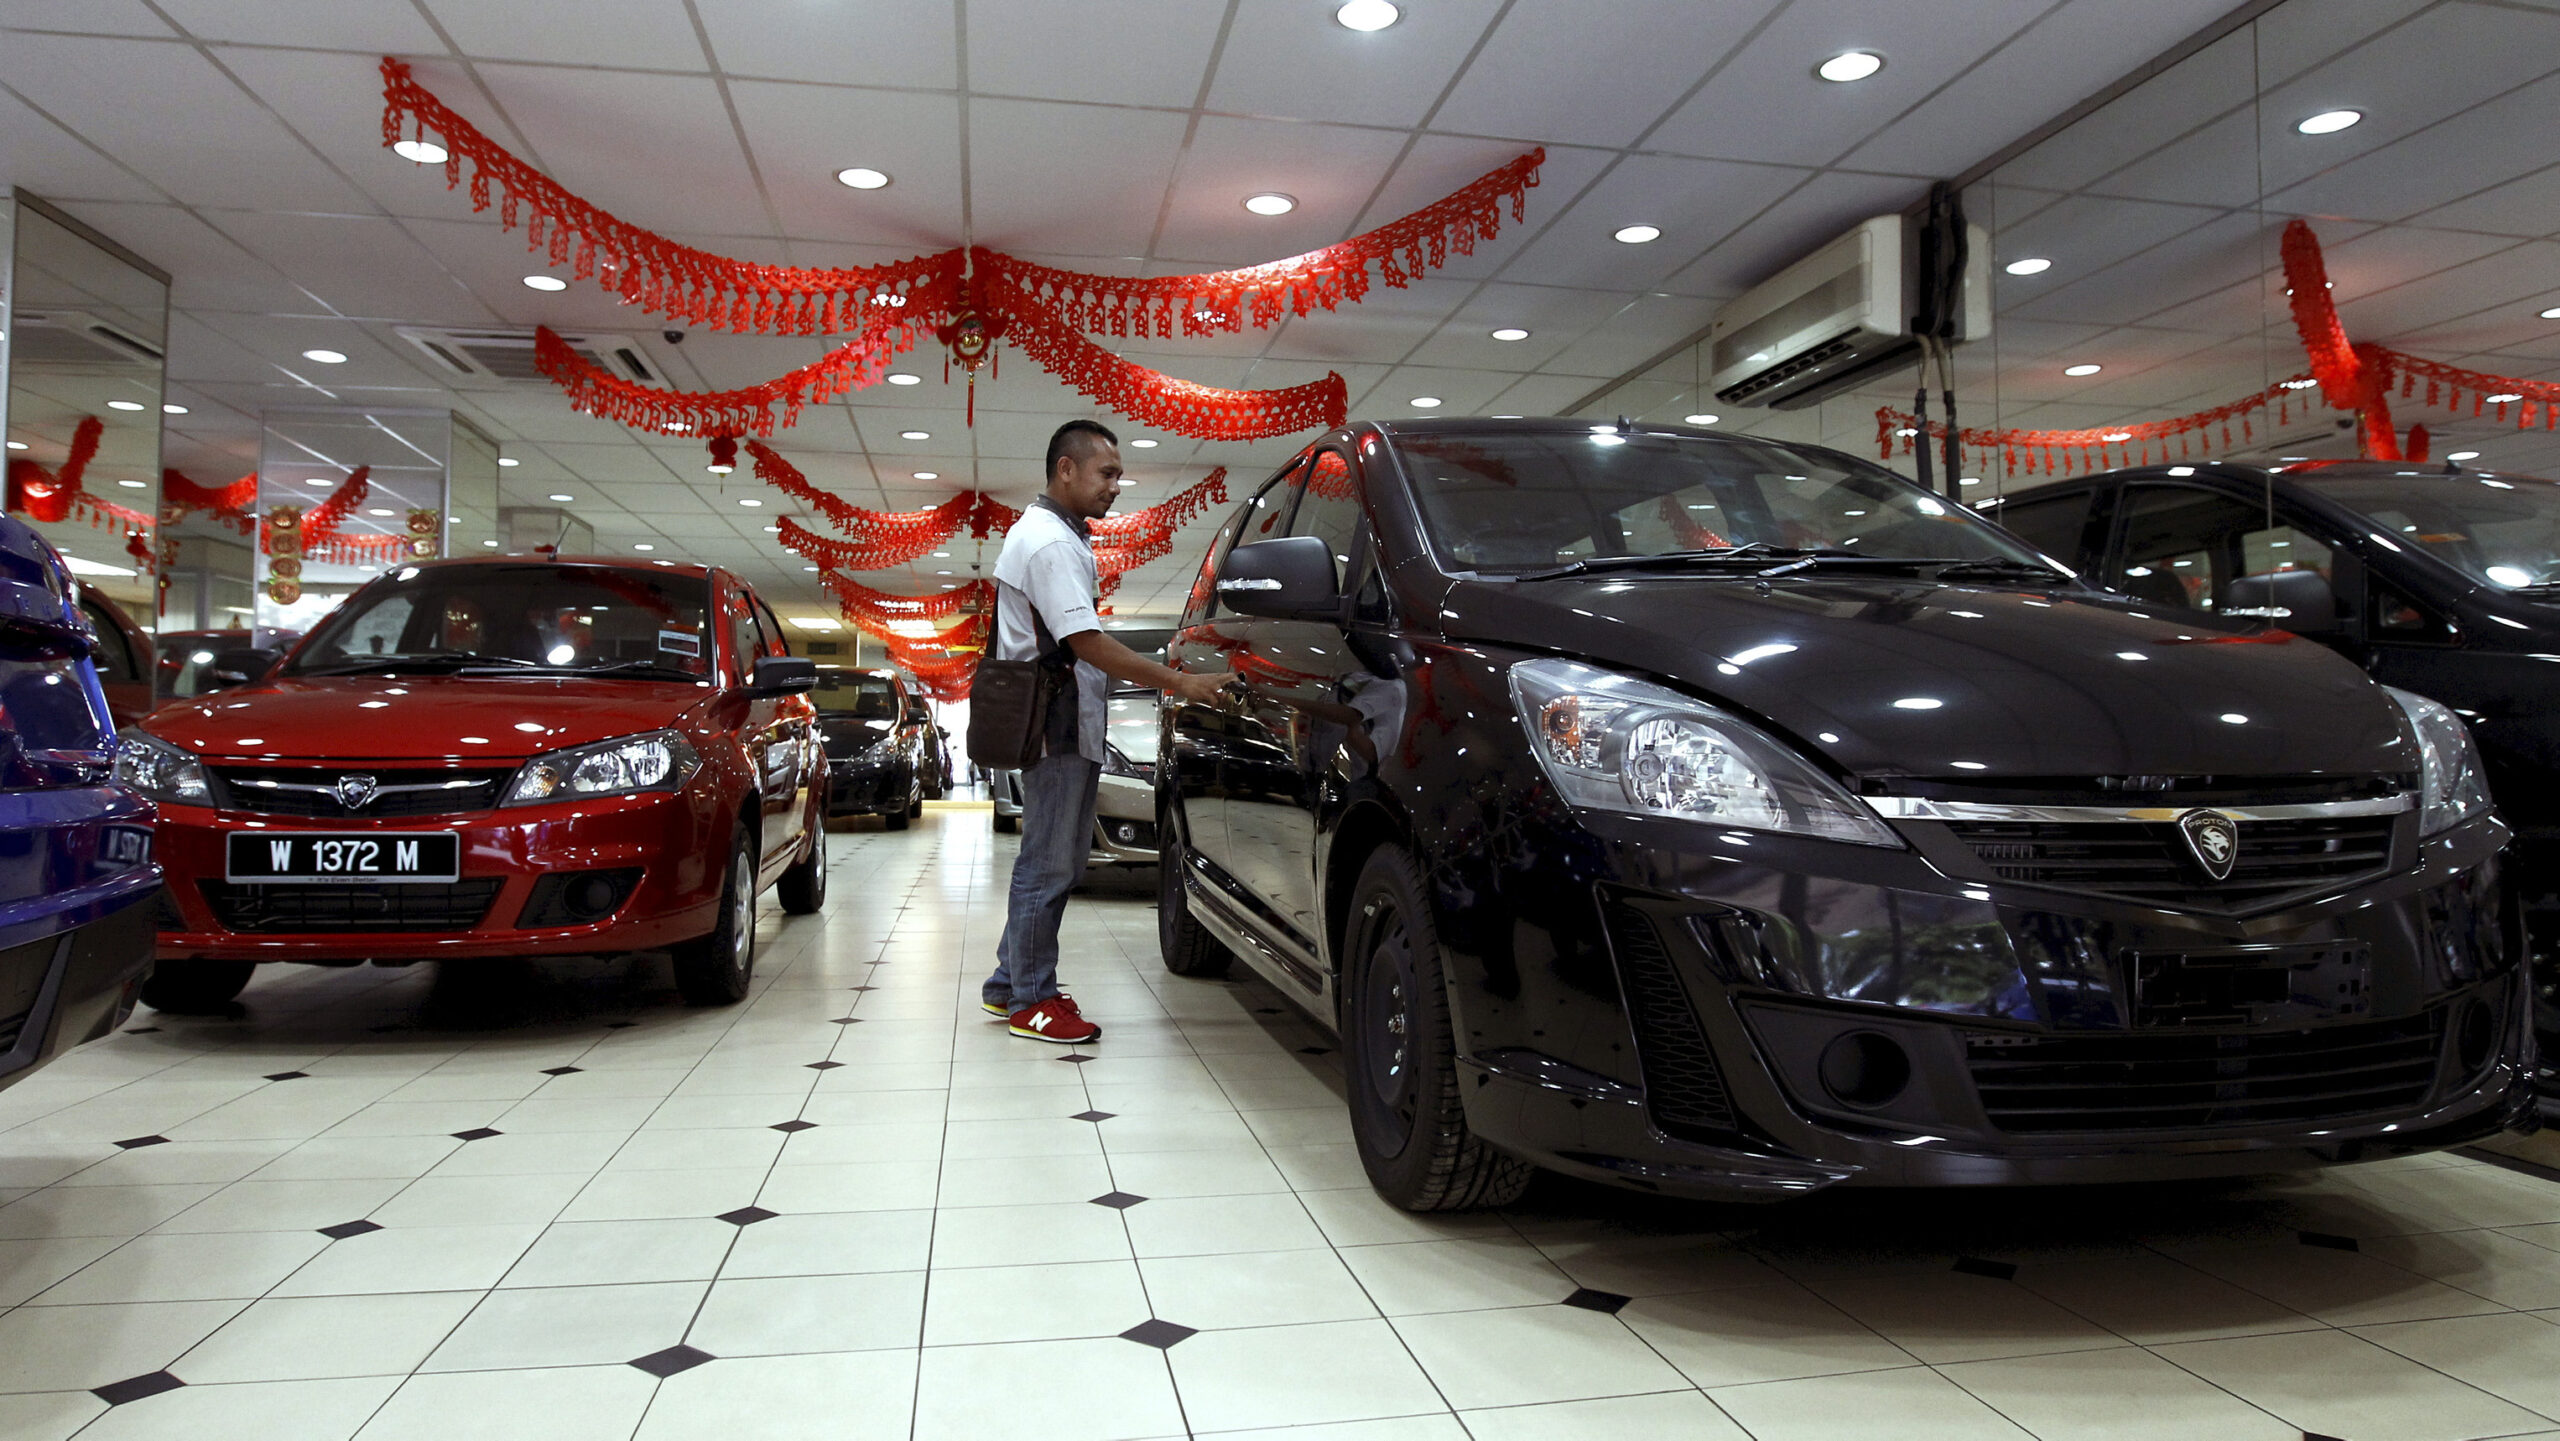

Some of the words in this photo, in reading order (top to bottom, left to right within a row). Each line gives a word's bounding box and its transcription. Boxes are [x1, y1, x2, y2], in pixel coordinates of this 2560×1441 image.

[2188, 818, 2232, 828] PROTON
[270, 840, 292, 871] W
[312, 841, 379, 872] 1372
[396, 840, 418, 871] M
[1027, 1010, 1053, 1032] N
